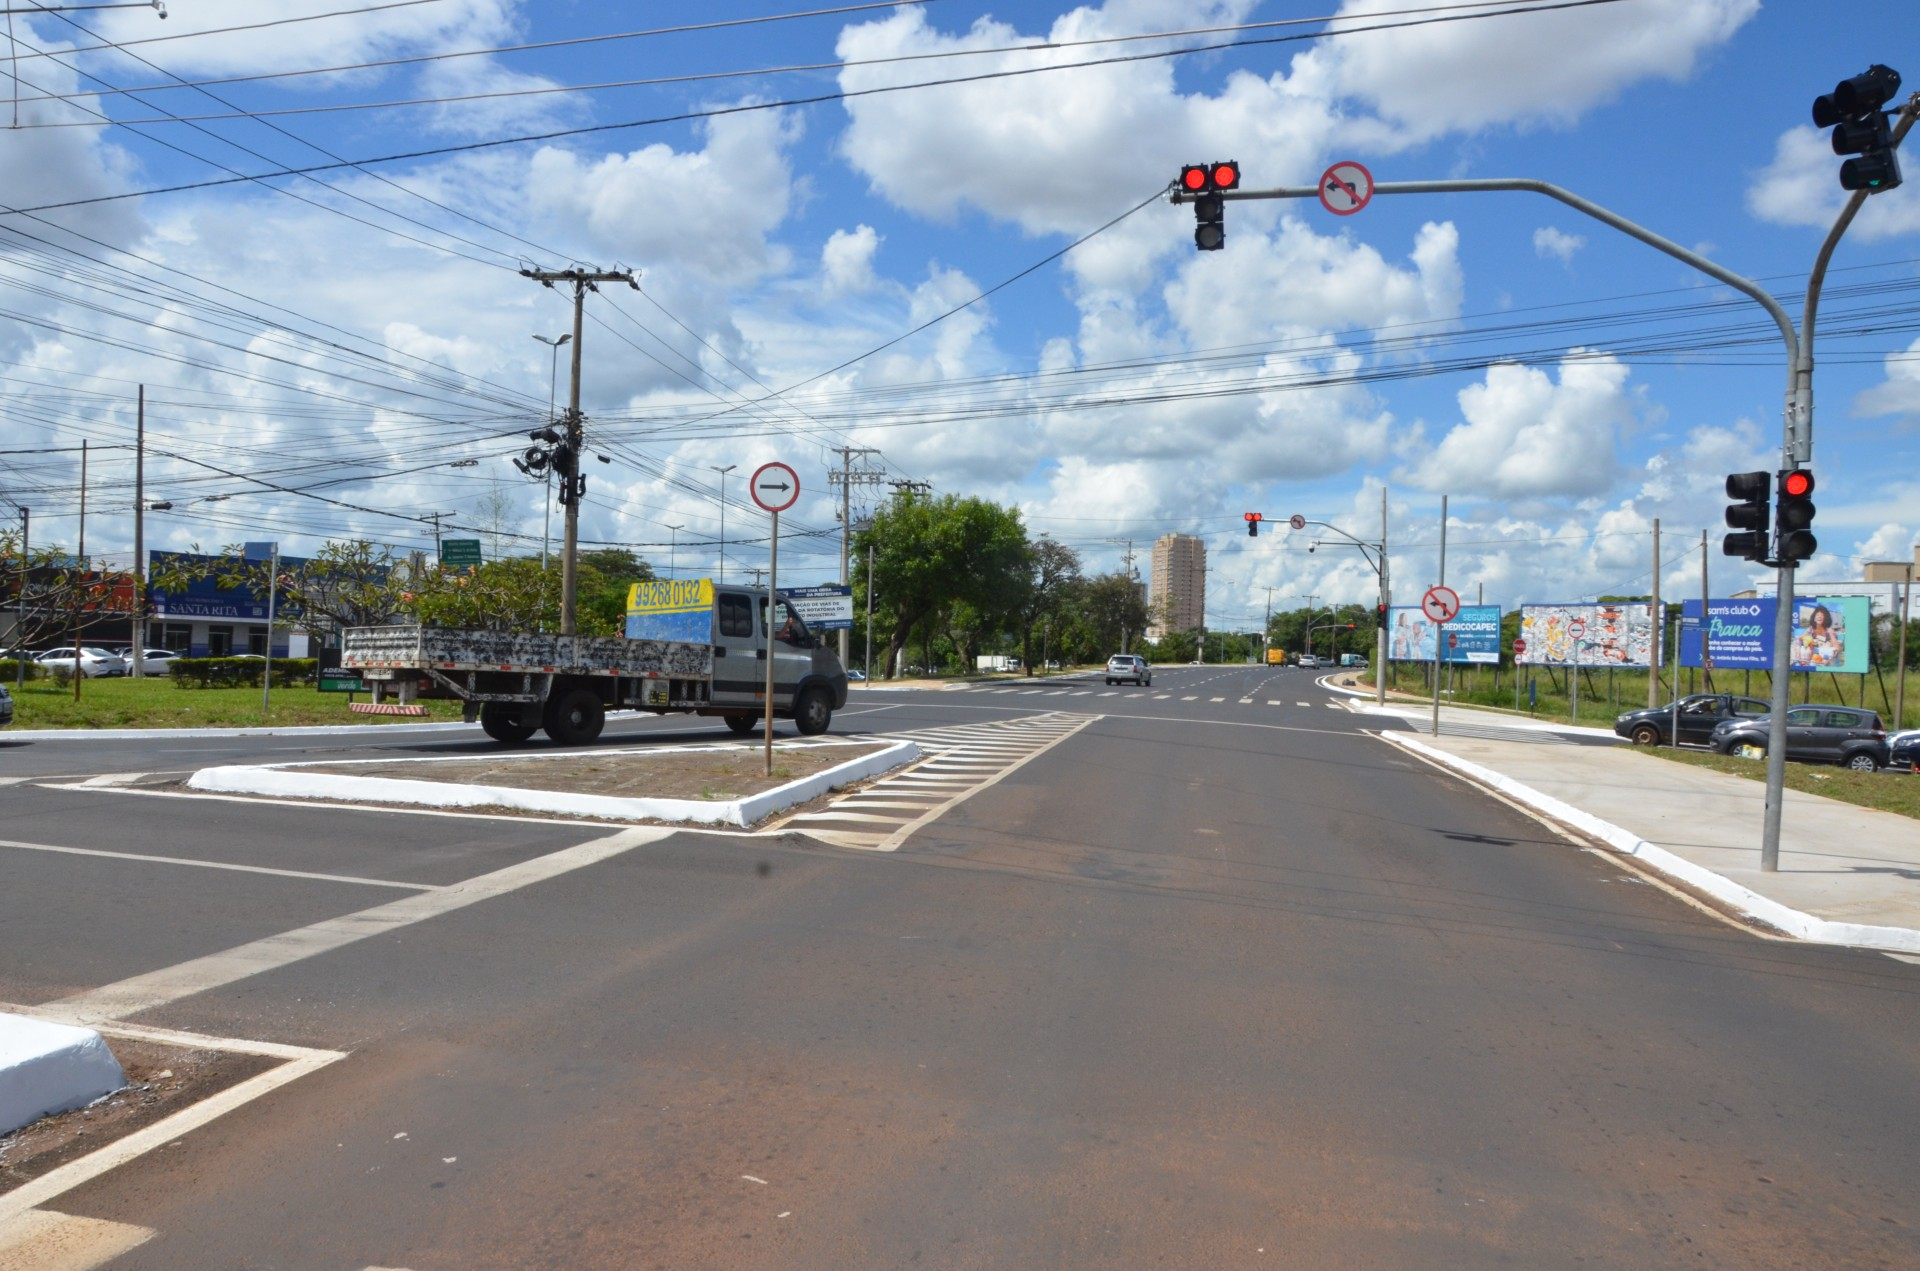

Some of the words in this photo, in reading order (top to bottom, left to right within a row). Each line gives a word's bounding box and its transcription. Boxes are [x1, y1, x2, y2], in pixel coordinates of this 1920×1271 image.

[635, 582, 671, 607] 99268
[673, 579, 700, 605] 0132
[170, 603, 209, 615] SANTA
[211, 605, 238, 616] RITA
[1707, 606, 1729, 615] sam's
[1730, 605, 1748, 615] club
[1462, 613, 1497, 622] SEGUROS
[1441, 622, 1497, 632] REDICOCAPEC
[1708, 615, 1763, 639] Franca
